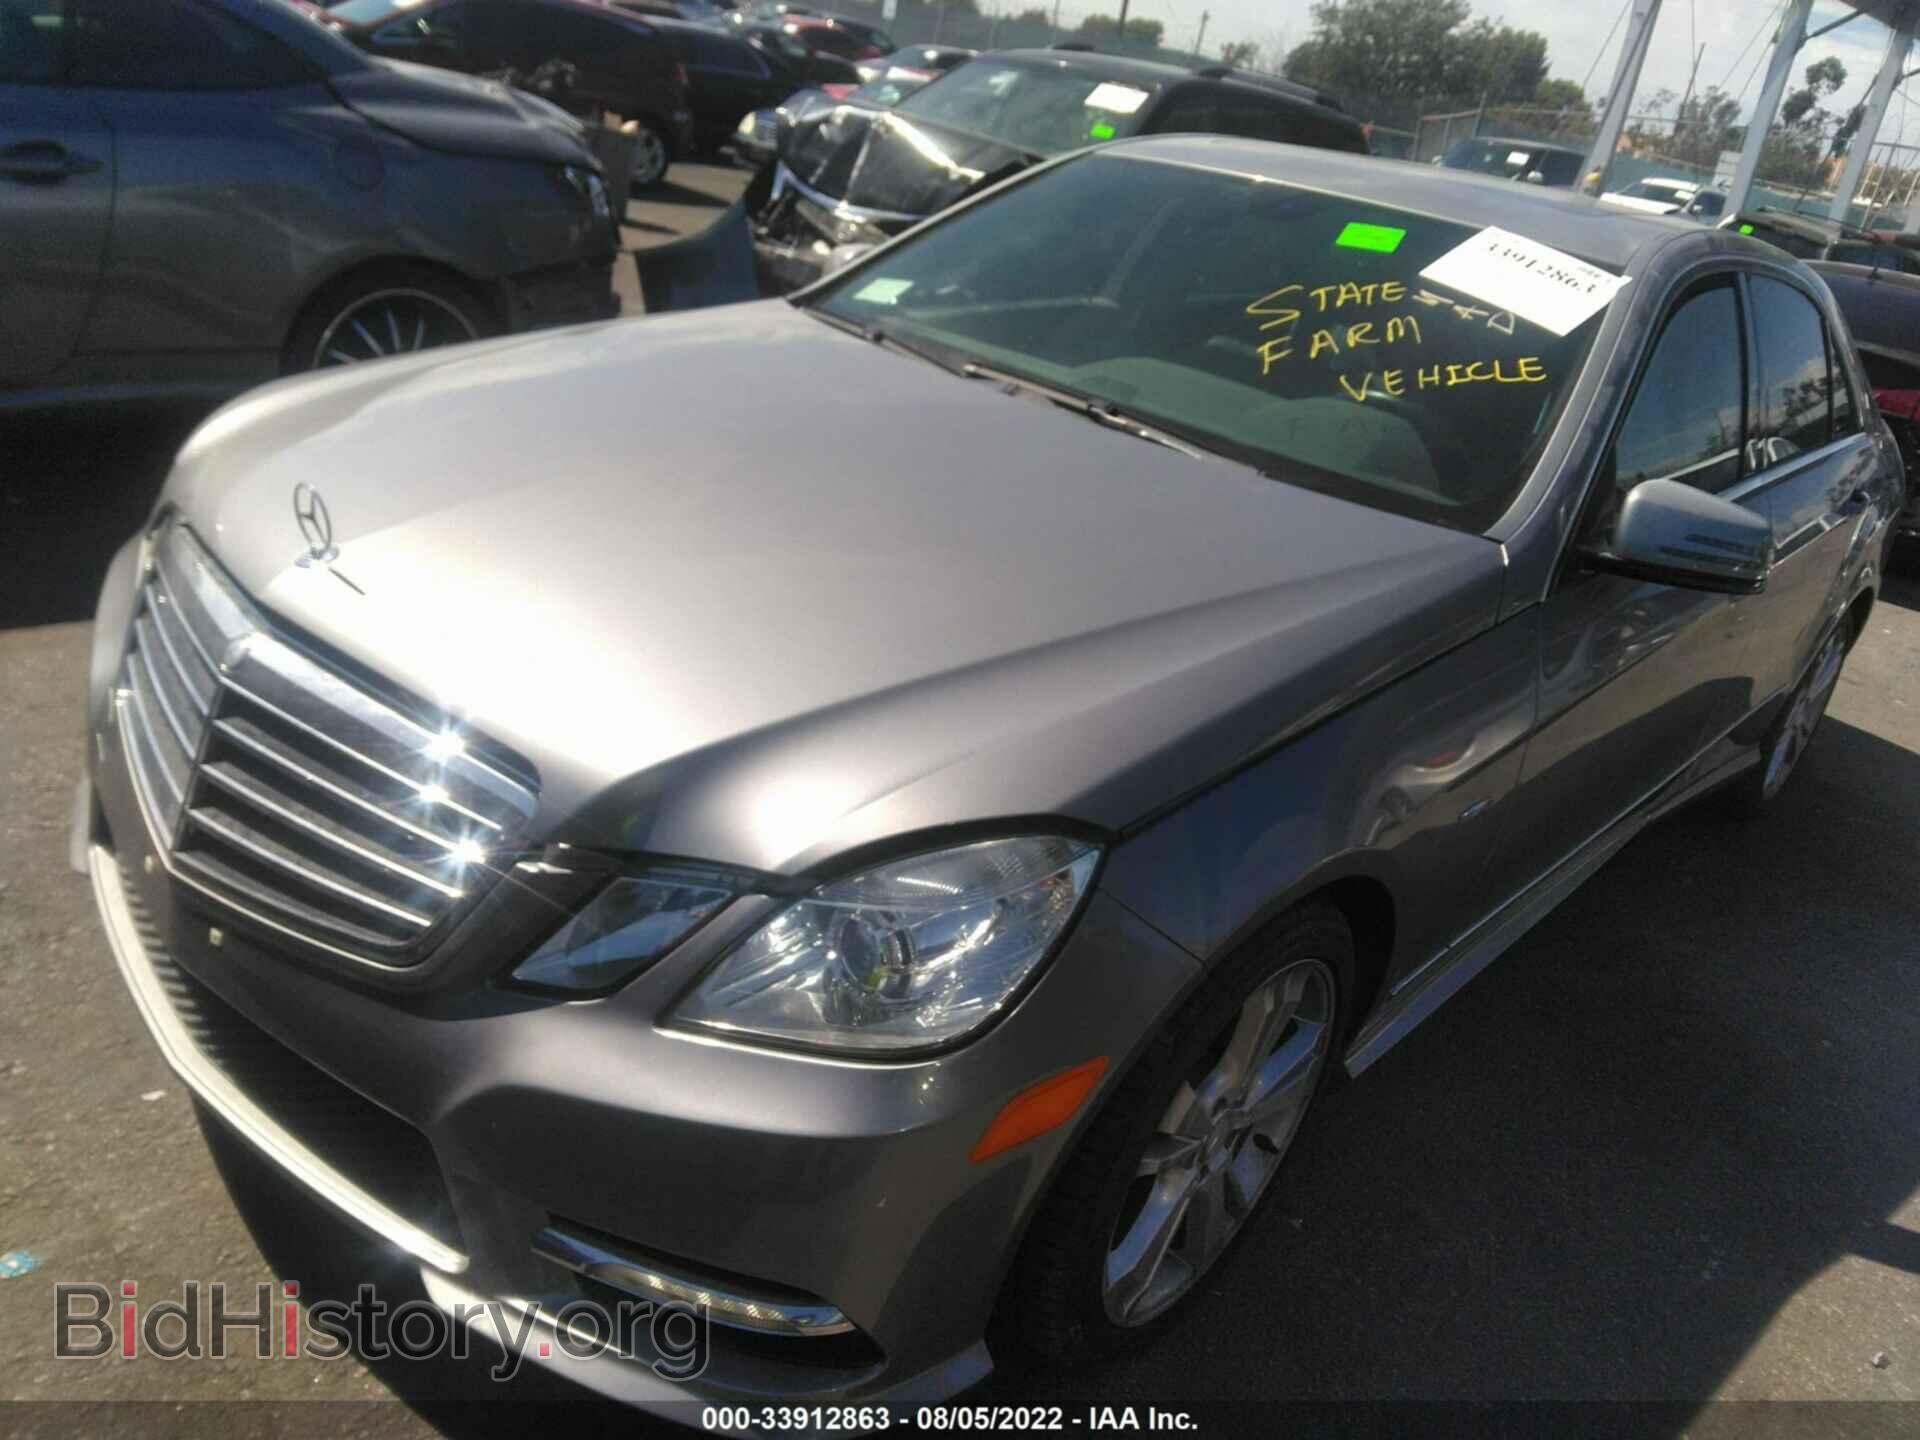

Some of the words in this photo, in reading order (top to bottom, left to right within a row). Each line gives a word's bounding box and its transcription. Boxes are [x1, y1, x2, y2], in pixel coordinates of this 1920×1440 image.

[1246, 281, 1407, 331] STATE
[1256, 315, 1421, 375] FARM
[1339, 356, 1548, 402] VEHICLE
